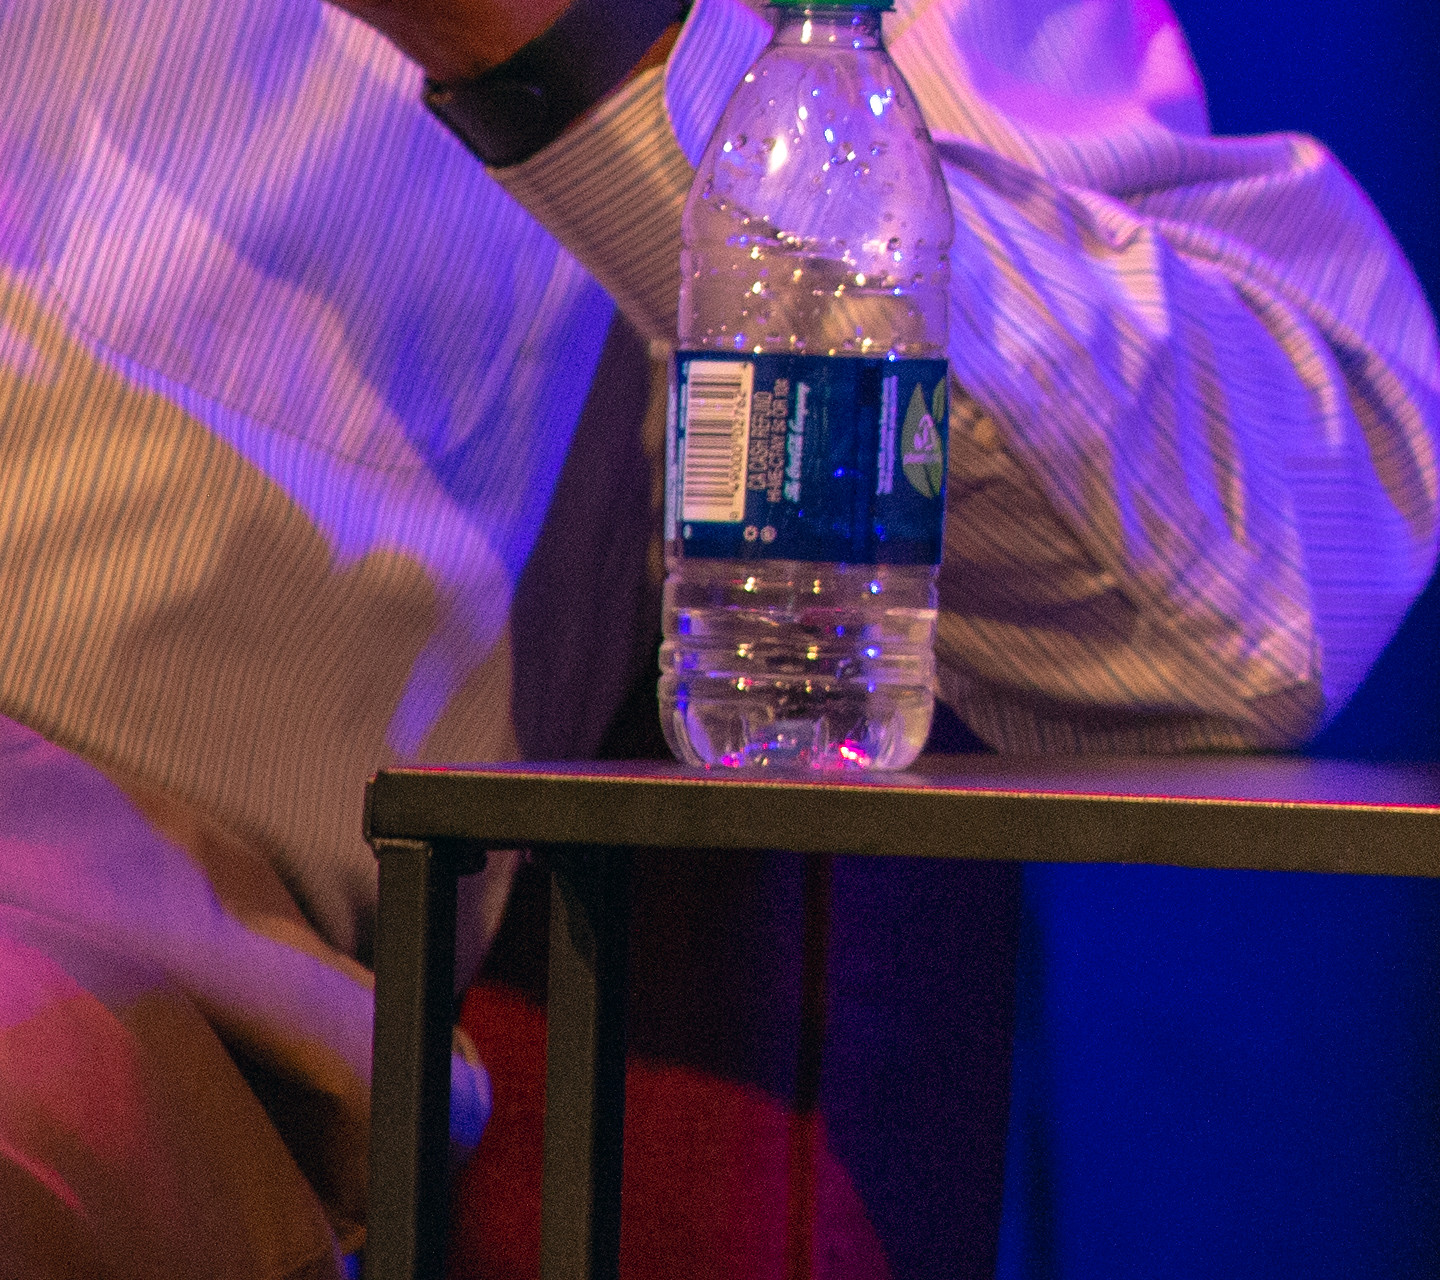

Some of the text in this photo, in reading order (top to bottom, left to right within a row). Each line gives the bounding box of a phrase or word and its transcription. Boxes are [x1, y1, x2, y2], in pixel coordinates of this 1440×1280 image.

[746, 391, 774, 490] CA CASH REFUND
[788, 382, 811, 432] Company
